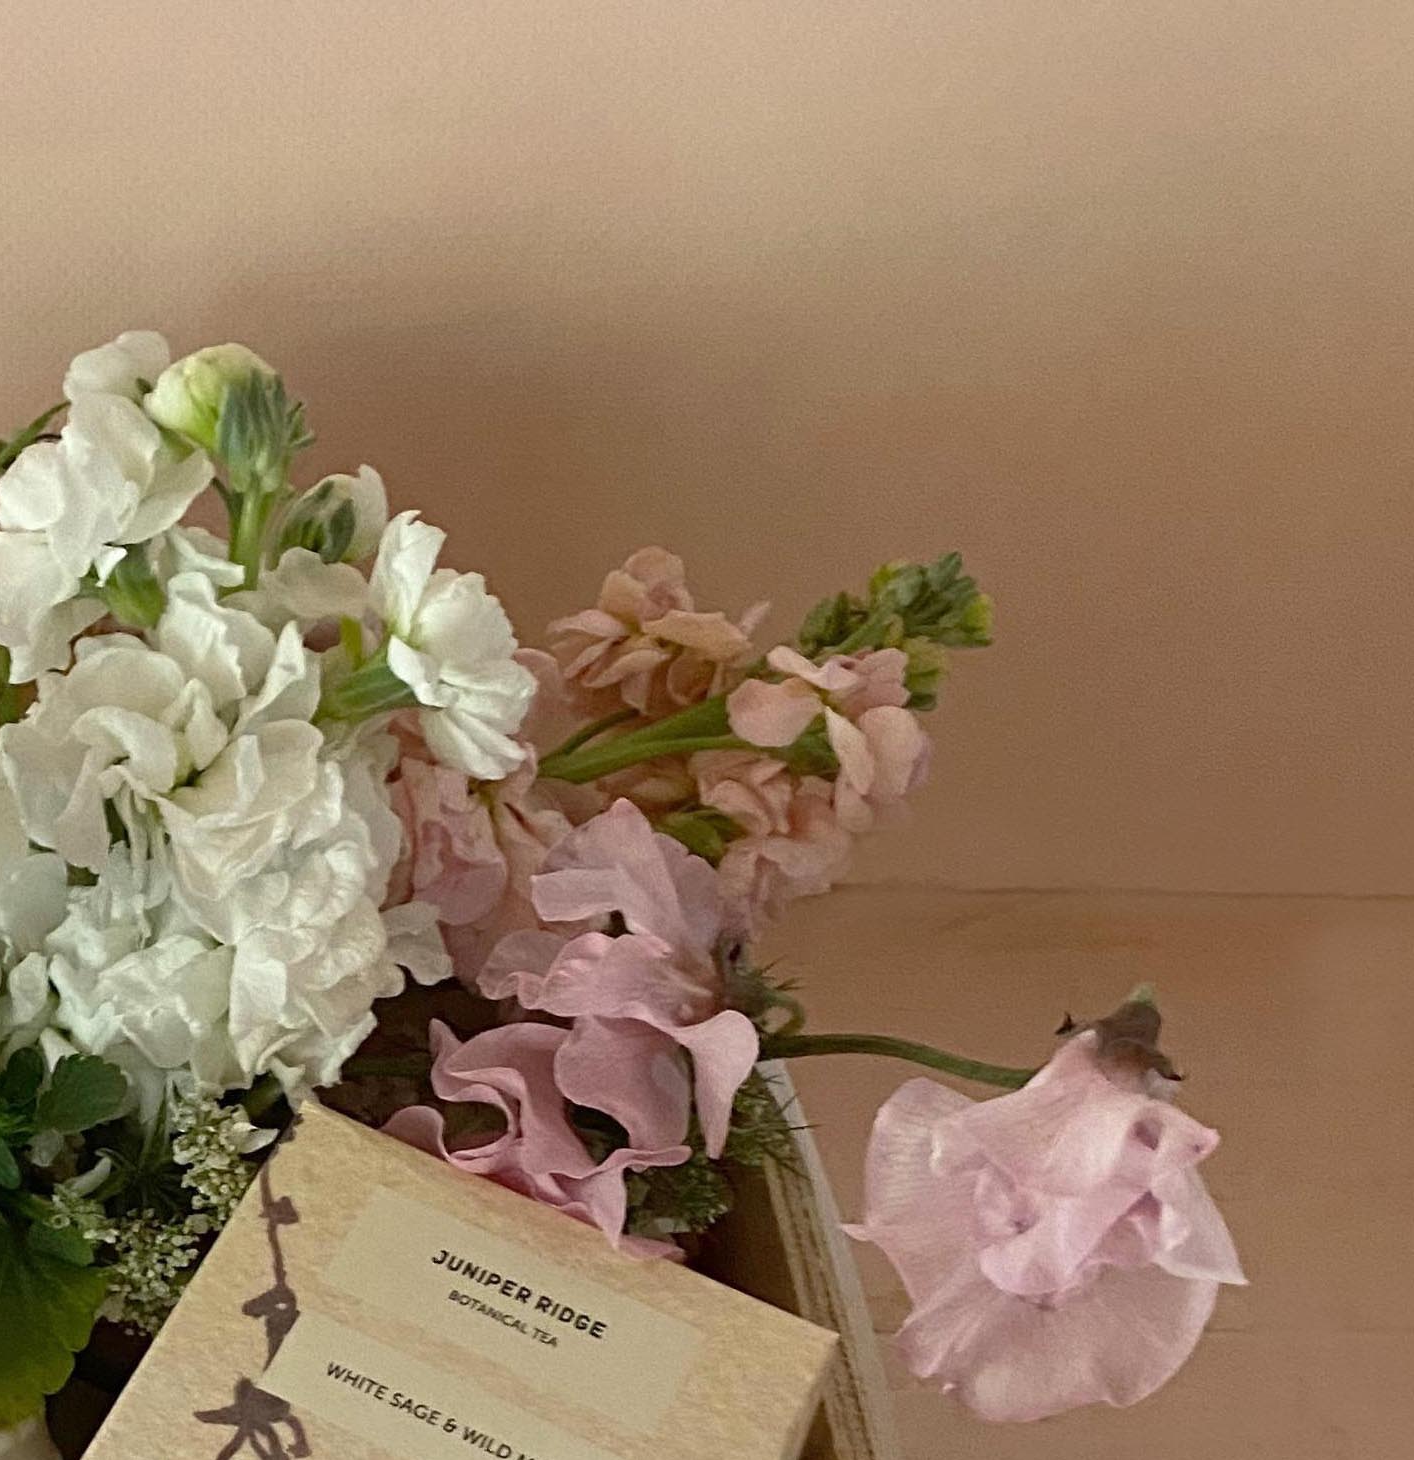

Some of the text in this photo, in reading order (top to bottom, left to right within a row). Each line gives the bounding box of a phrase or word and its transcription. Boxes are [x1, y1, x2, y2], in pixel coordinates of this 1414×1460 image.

[431, 1249, 608, 1340] JUNIPER RIDGE
[447, 1289, 560, 1348] BOTANICAL TEA
[326, 1361, 387, 1401] WHITE
[389, 1392, 442, 1426] SAGE
[443, 1418, 458, 1434] &
[461, 1426, 513, 1460] WILD
